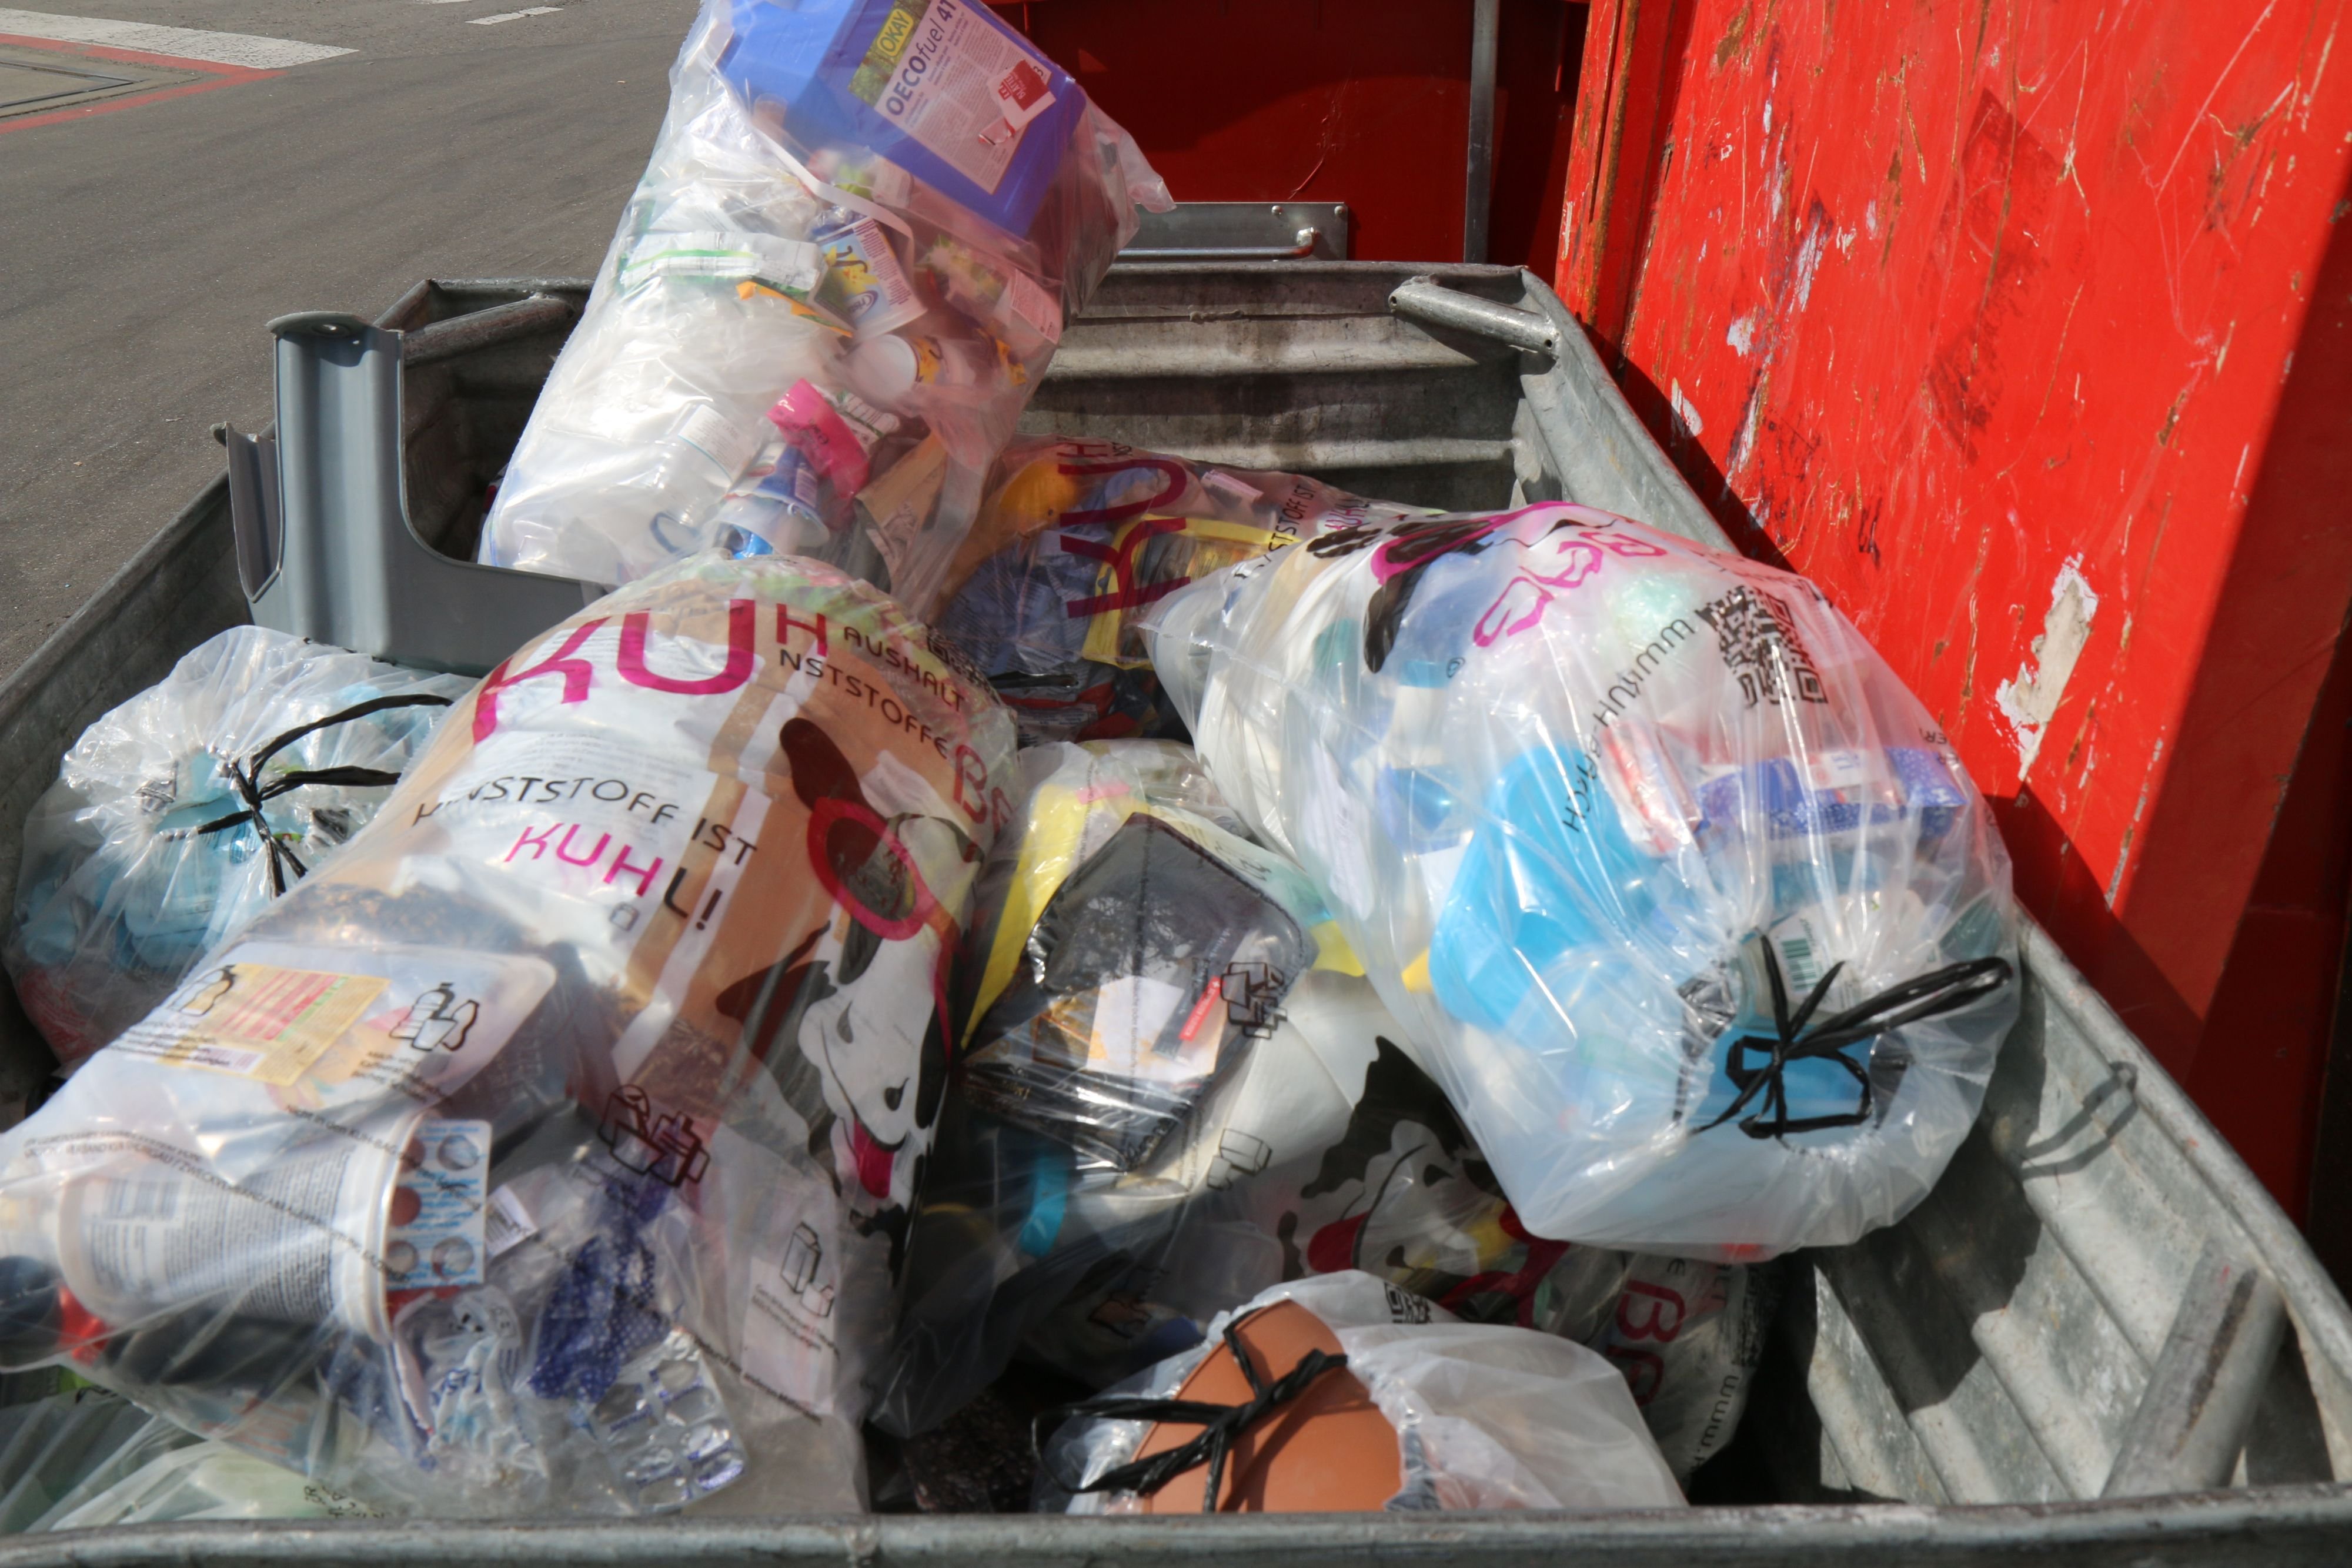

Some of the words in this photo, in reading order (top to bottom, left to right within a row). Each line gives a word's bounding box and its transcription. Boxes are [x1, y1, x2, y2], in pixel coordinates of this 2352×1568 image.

[880, 11, 910, 53] OKAY
[472, 599, 828, 745] KUH
[780, 648, 948, 760] NSTSTOFFE
[504, 822, 723, 931] KUHL!
[691, 817, 757, 866] IST
